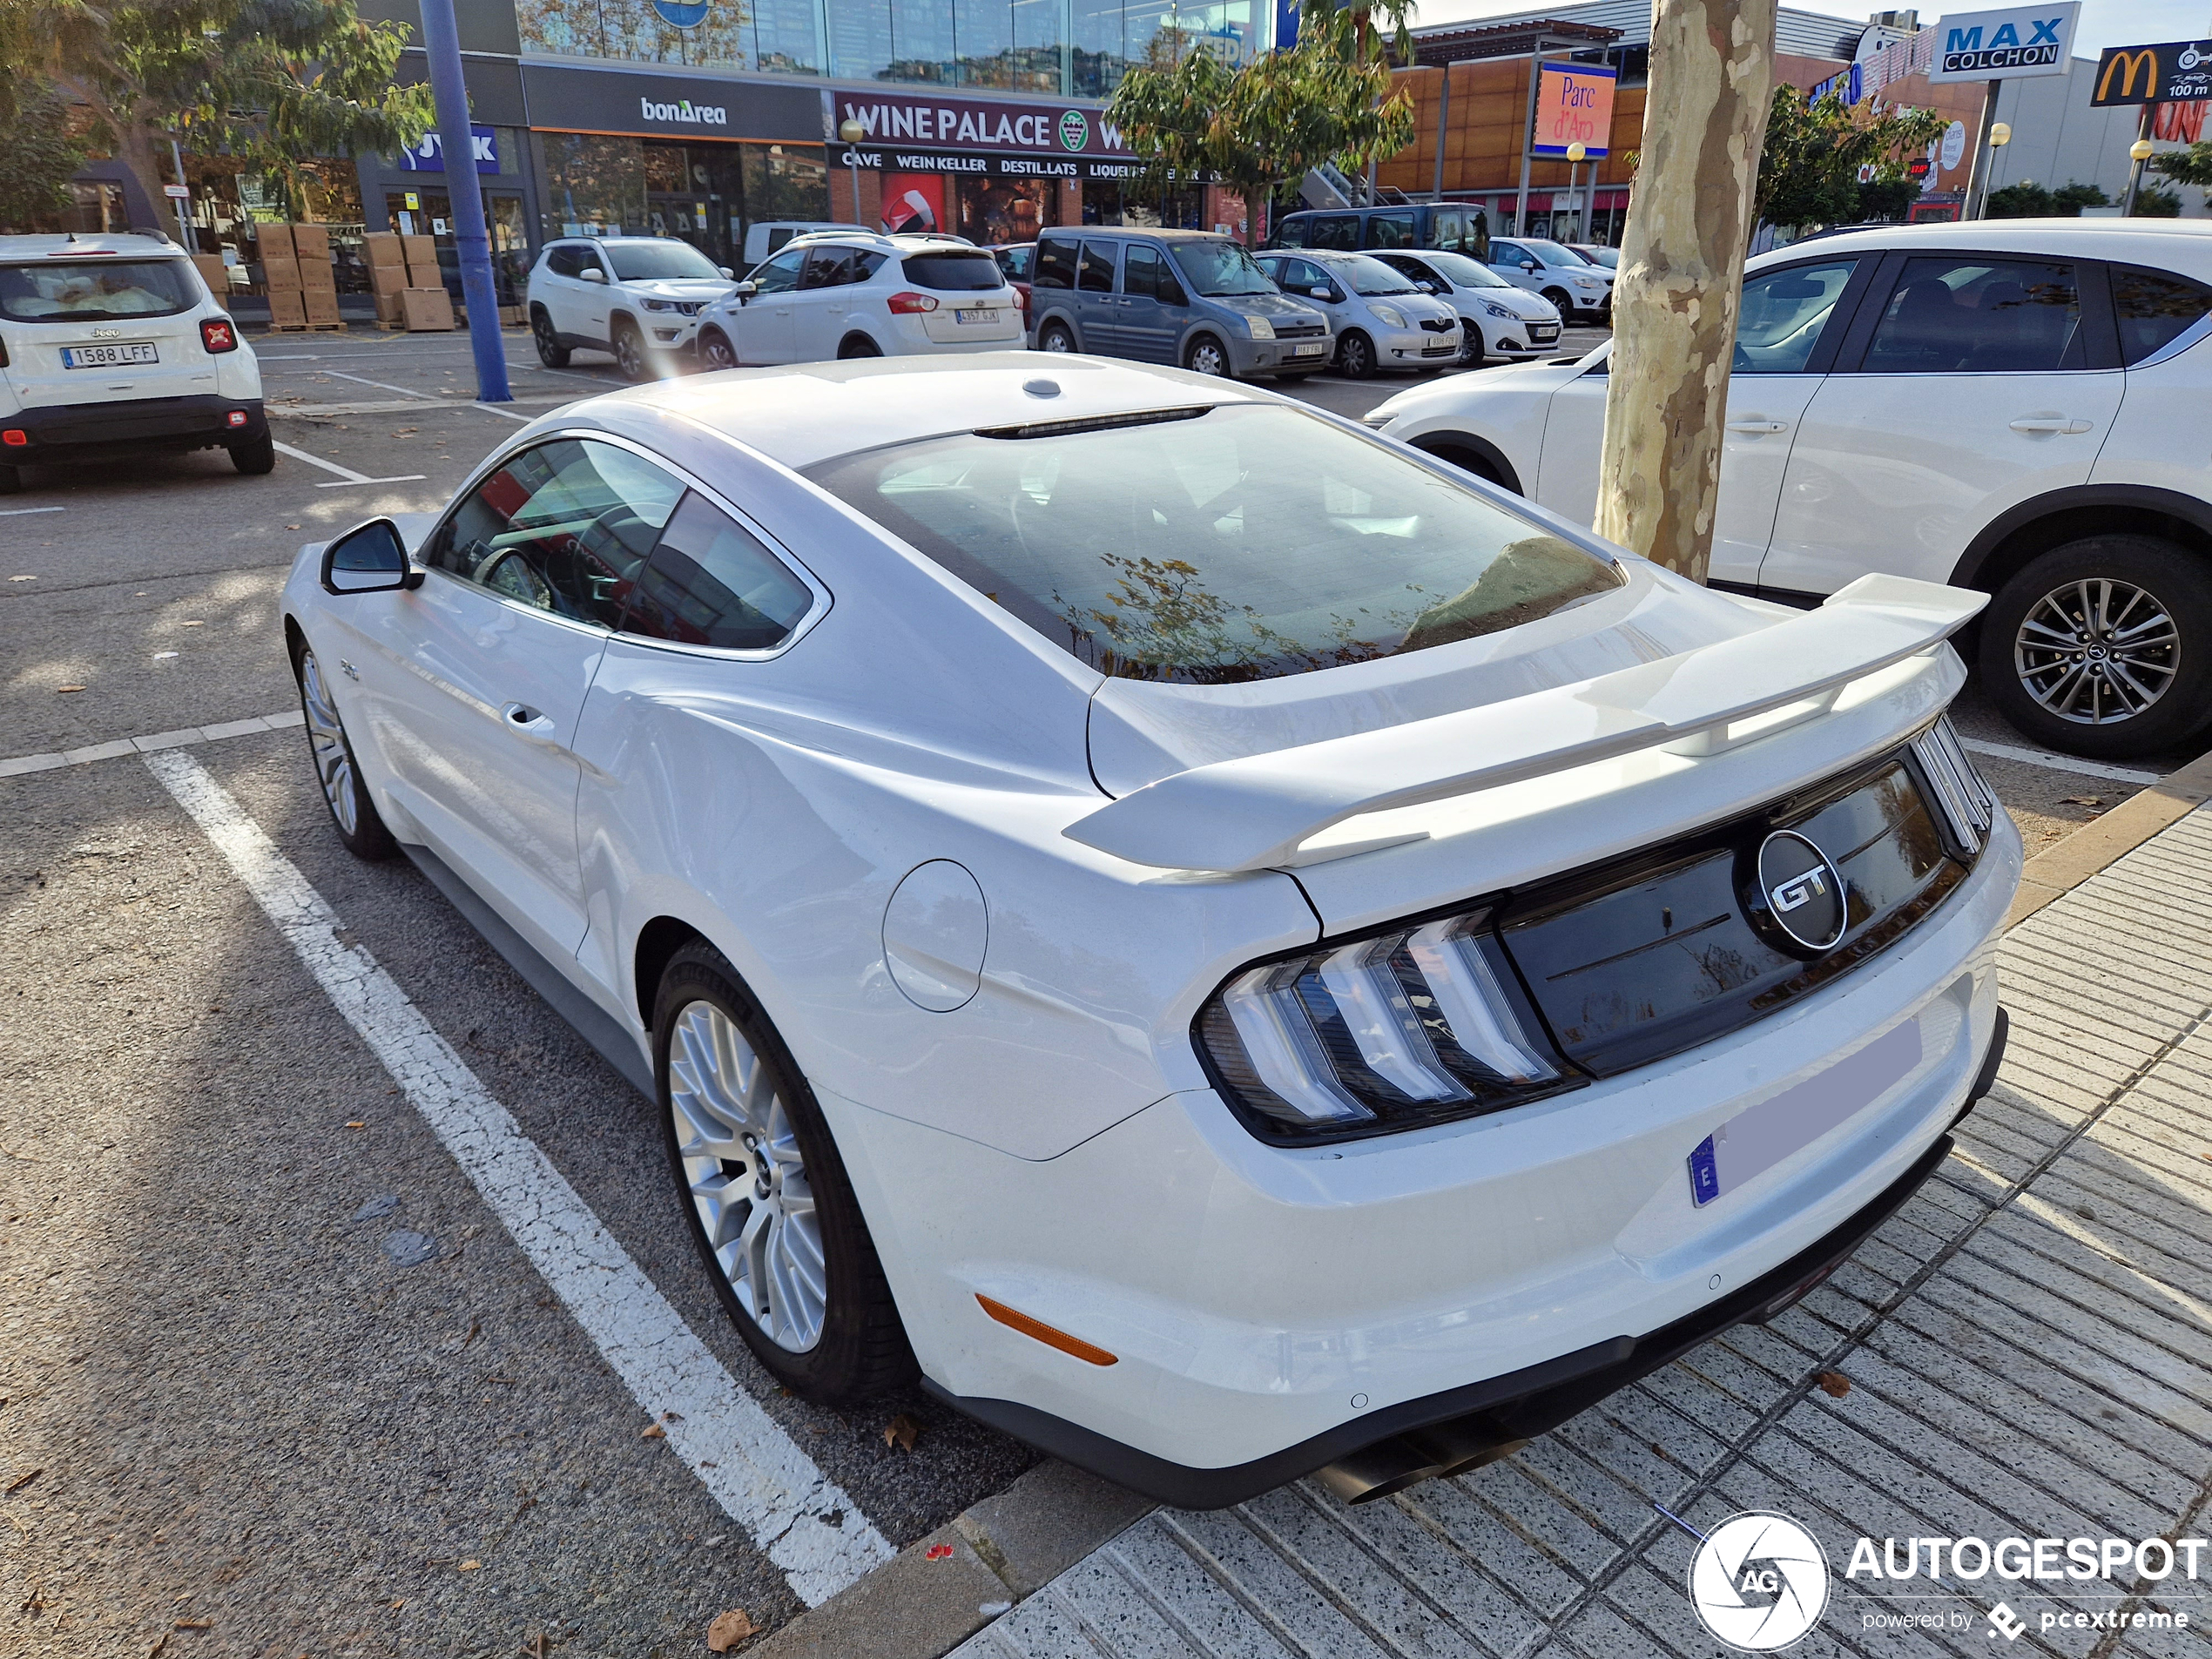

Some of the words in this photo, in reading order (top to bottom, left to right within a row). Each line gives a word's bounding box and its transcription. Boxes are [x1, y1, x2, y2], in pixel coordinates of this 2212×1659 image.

[1946, 17, 2064, 52] MAX
[1944, 46, 2058, 71] COLCHON
[1561, 76, 1595, 108] Parc
[2168, 84, 2192, 97] 100
[2194, 85, 2209, 96] m
[844, 103, 934, 139] WINE
[938, 109, 1051, 146] PALACE
[1554, 110, 1594, 141] d'Aro
[841, 152, 882, 167] CAVE
[937, 157, 987, 172] KELLER
[251, 212, 284, 224] 70%
[91, 328, 120, 338] Jeep
[76, 348, 117, 363] 1588
[120, 346, 150, 361] LFF
[1771, 864, 1826, 914] GT
[1701, 1166, 1711, 1187] E
